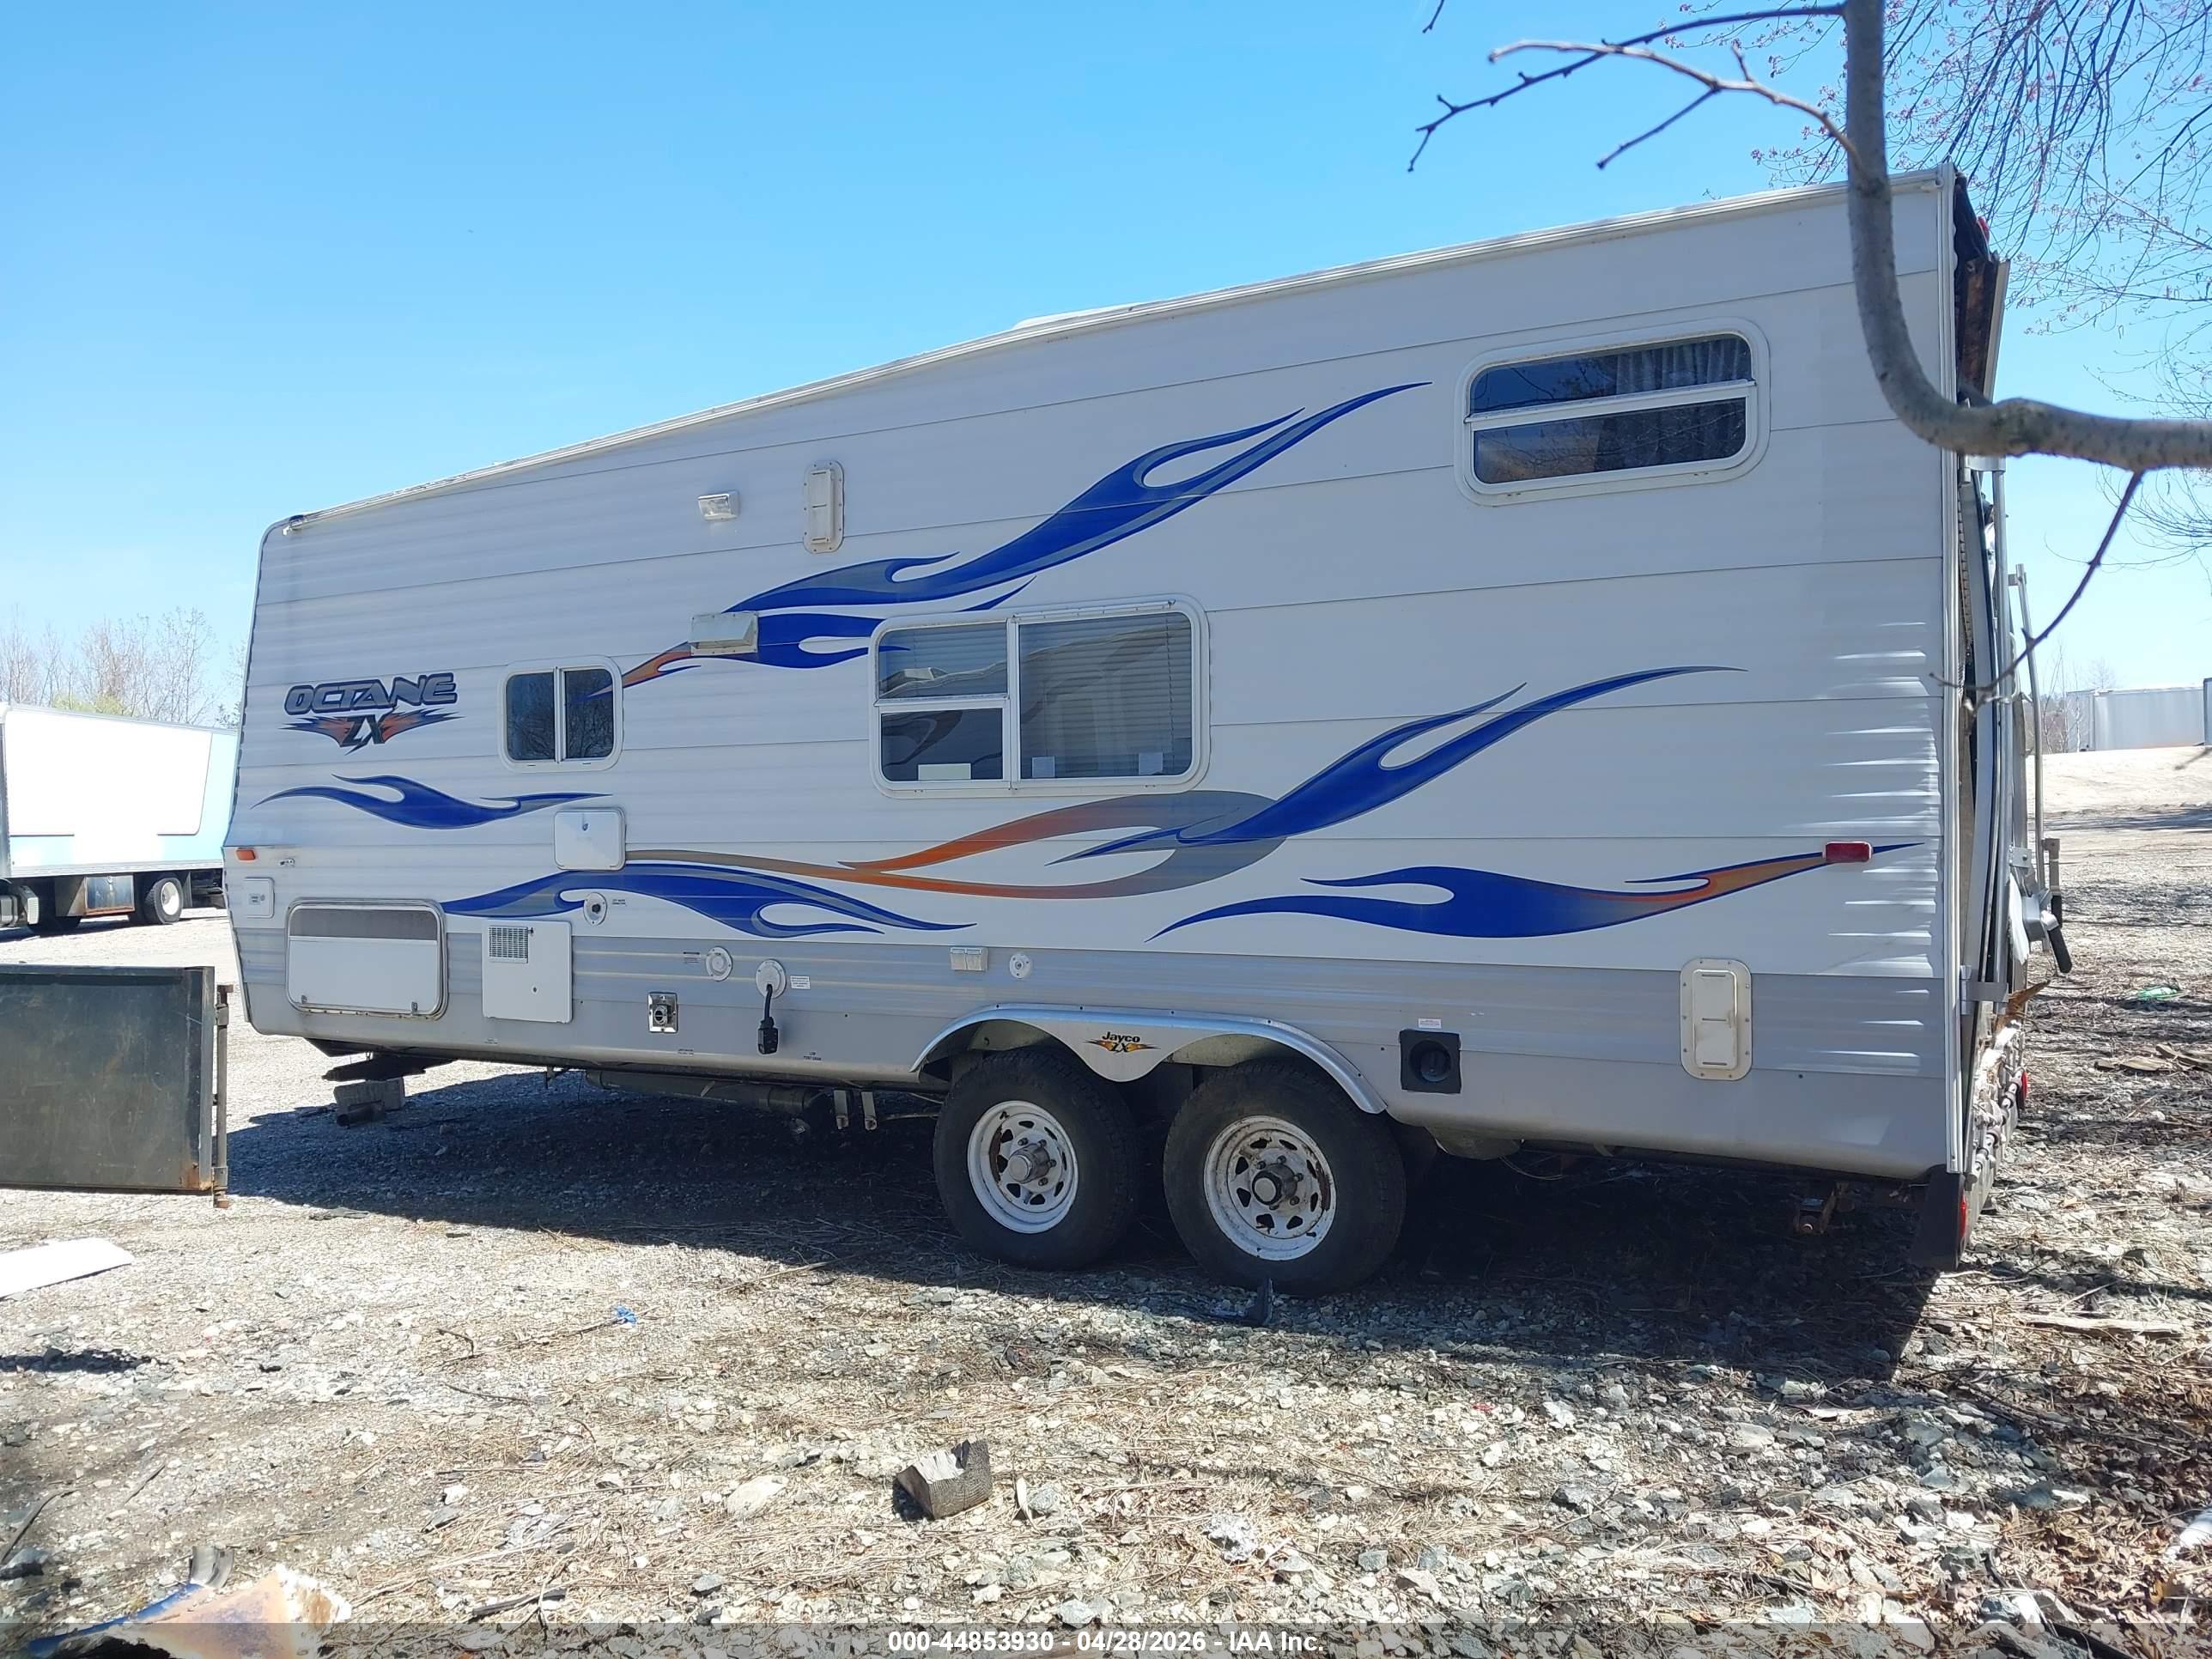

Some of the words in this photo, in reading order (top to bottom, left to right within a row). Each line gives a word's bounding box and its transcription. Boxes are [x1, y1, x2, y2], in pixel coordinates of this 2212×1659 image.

[284, 672, 458, 715] OCTANE
[340, 708, 397, 756] ZX
[1102, 1031, 1141, 1043] Jayco
